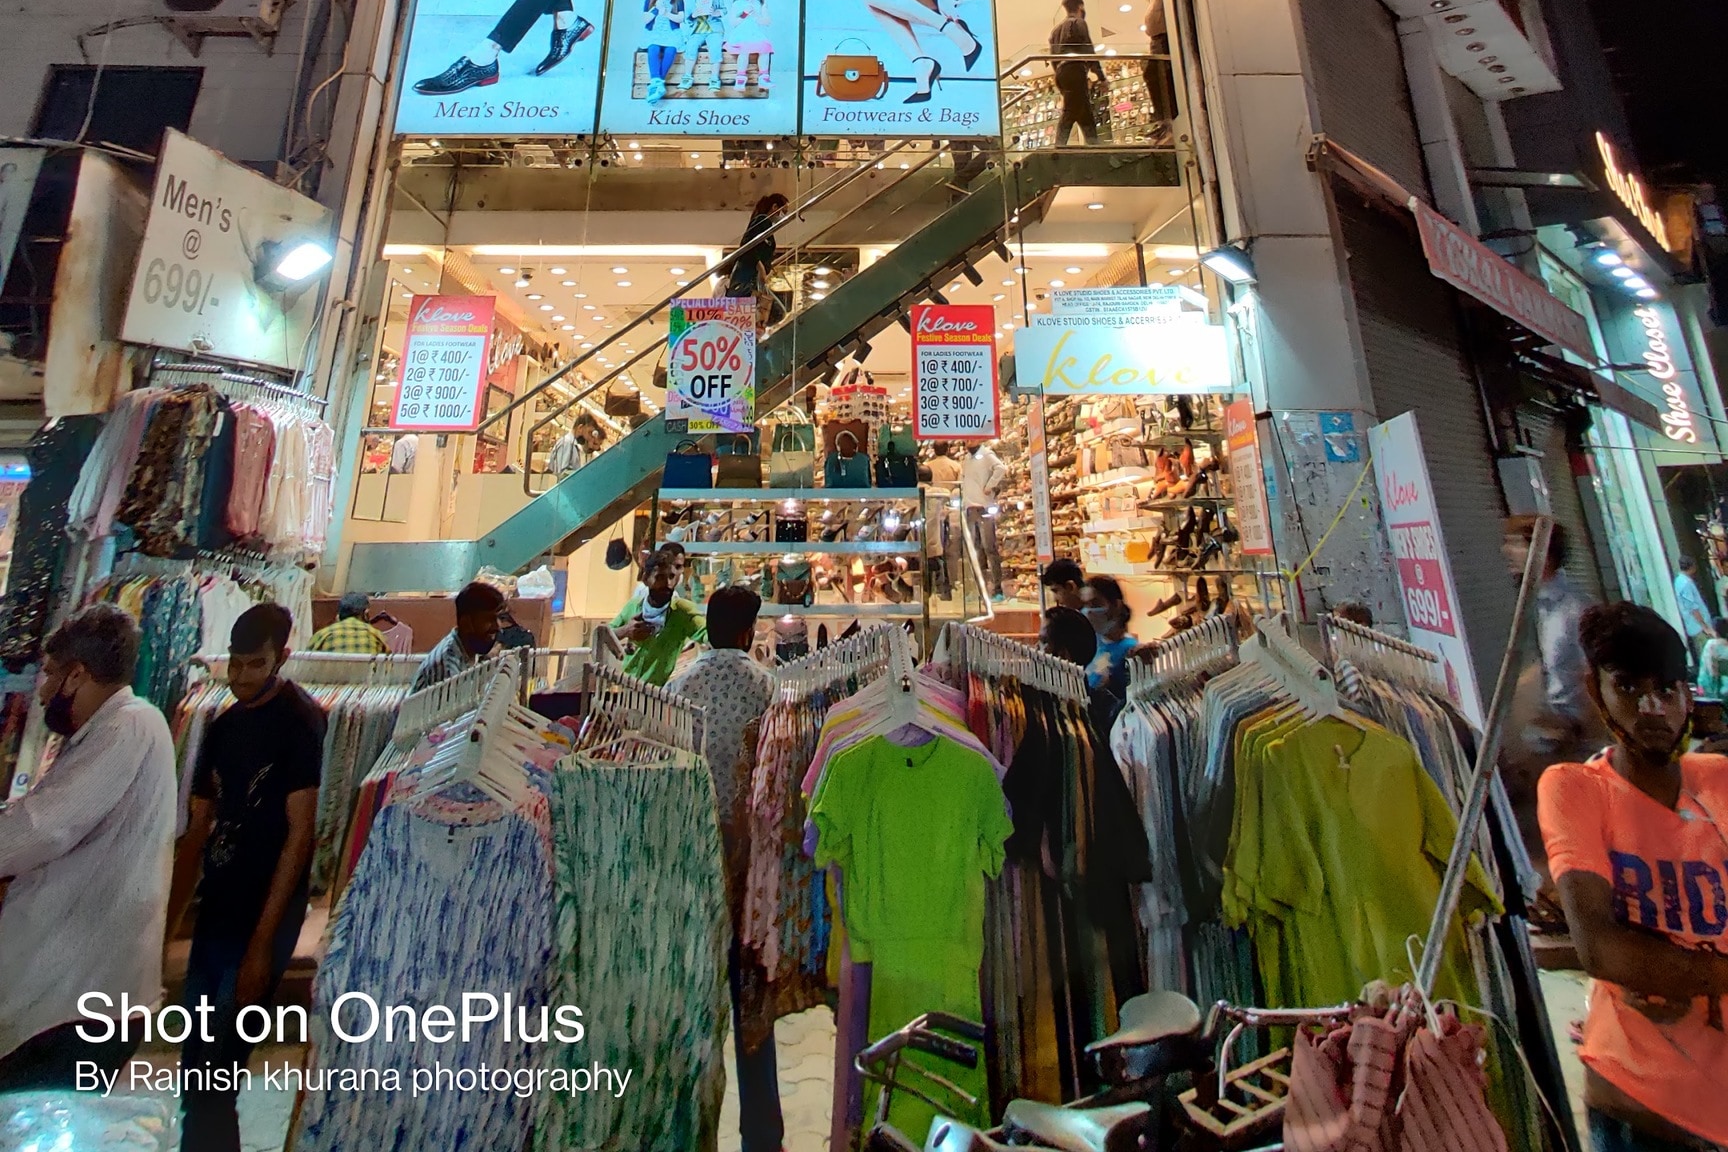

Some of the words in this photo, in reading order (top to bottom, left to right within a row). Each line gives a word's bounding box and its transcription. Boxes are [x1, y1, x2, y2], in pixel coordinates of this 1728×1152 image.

[434, 101, 495, 119] Men's
[500, 101, 560, 119] Shoes
[648, 109, 691, 126] Kids
[696, 109, 750, 126] Shoes
[822, 107, 912, 123] Footwears
[917, 107, 932, 123] &
[939, 107, 980, 126] Bags
[162, 174, 232, 233] Men's
[183, 228, 201, 260] @
[143, 258, 219, 315] 699/-
[670, 298, 708, 308] SPECIAL
[686, 309, 722, 321] 10%
[1037, 317, 1061, 326] KLOVE
[1063, 317, 1090, 326] STUDIO
[1091, 316, 1116, 325] SHOES
[1118, 316, 1124, 325] &
[916, 332, 943, 342] Festive
[944, 333, 970, 342] Season
[972, 334, 992, 342] Deals
[1633, 303, 1675, 380] Closet
[412, 350, 429, 364] 1@
[440, 350, 472, 364] 400/-
[681, 336, 741, 372] 50%
[406, 367, 426, 382] 2@
[438, 368, 470, 382] 700/-
[922, 360, 938, 374] 1@
[951, 360, 982, 374] 400/-
[404, 385, 423, 400] 3@
[435, 386, 467, 400] 900/-
[690, 374, 732, 399] OFF
[920, 378, 939, 392] 2@
[952, 378, 983, 392] 700/-
[400, 403, 420, 418] 5@
[434, 404, 472, 418] 1000/-
[920, 395, 940, 410] 3@
[952, 396, 984, 410] 900/-
[1660, 381, 1697, 444] Shoe
[921, 414, 940, 428] 5@
[954, 414, 992, 428] 1000/-
[1407, 586, 1449, 628] 699/-
[1609, 850, 1728, 937] RID
